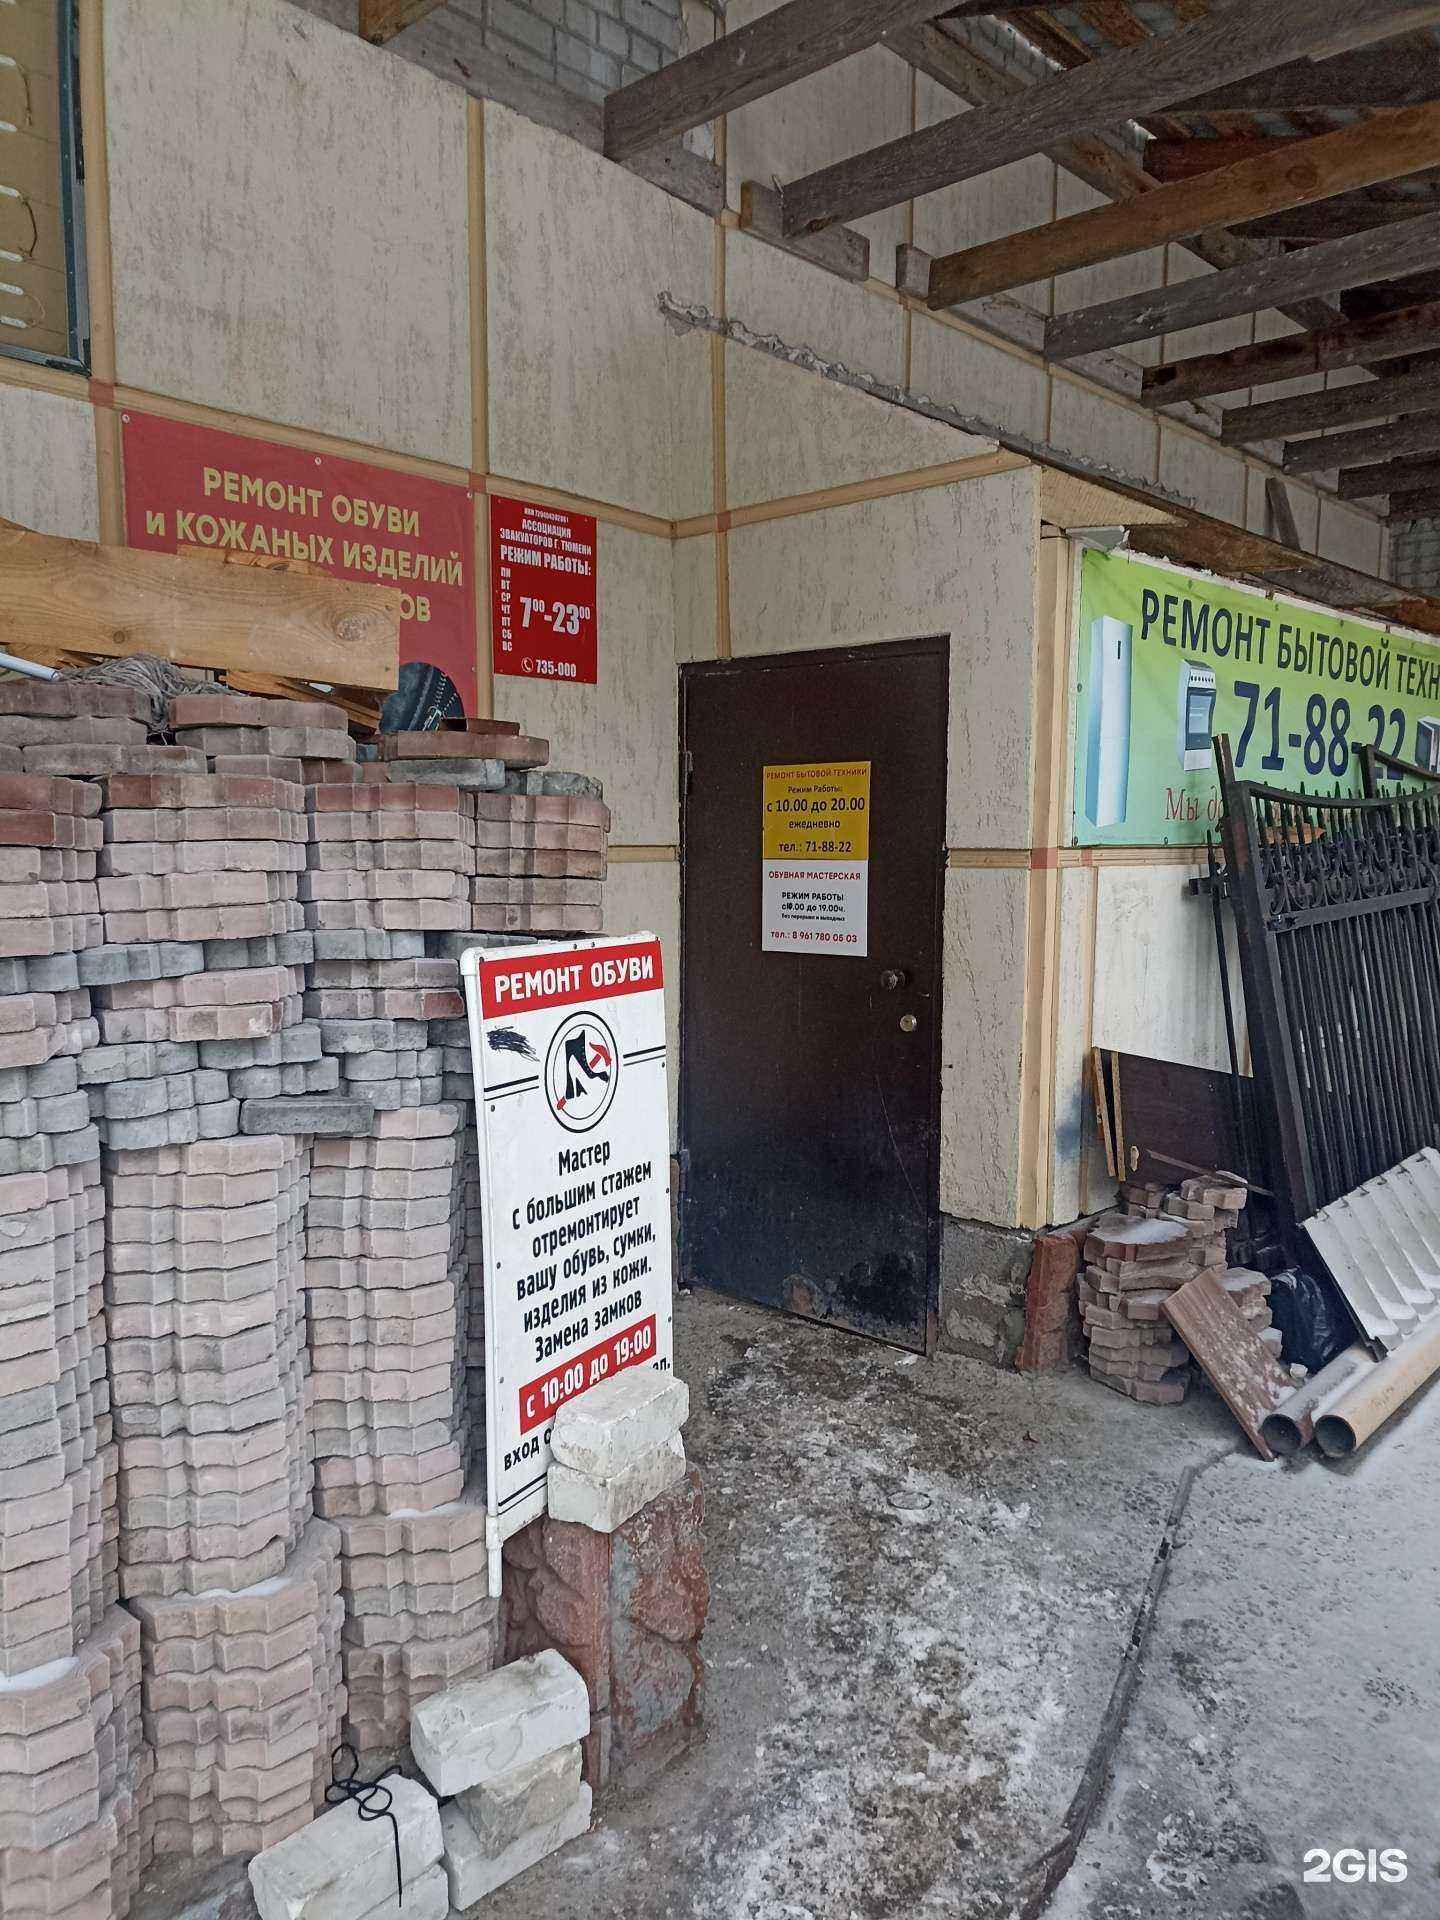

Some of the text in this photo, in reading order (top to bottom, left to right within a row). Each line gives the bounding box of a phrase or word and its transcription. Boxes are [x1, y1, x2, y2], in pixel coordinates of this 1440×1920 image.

[203, 467, 419, 537] РЕМОНТ ОБУВИ
[521, 519, 572, 539] АССОЦИАЦИЯ
[176, 510, 334, 565] КОЖАНЫХ
[343, 541, 463, 586] ИЗДЕЛИЙ
[500, 528, 553, 548] ЭВАКУАТОРОВ
[561, 540, 592, 556] ТЮМЕНИ
[500, 544, 592, 577] РЕЖИМ РАБОТЫ:
[500, 567, 511, 578] ПН
[501, 579, 511, 590] ВТ
[501, 592, 511, 603] СР
[501, 604, 511, 615] ЧТ
[501, 617, 511, 627] ПТ
[501, 629, 512, 640] СБ
[1141, 588, 1271, 664] РЕМОНТ
[1277, 624, 1391, 691] БЫТОВОЙ
[502, 641, 513, 652] ВС
[536, 659, 577, 678] 735-000
[1233, 681, 1406, 781] 71-88-22
[767, 768, 867, 780] РЕМОНТ БЫТОВОЙ ТЕХНИКИ
[788, 786, 812, 794] Режим
[775, 799, 808, 812] 10.00
[811, 801, 827, 814] до
[831, 797, 865, 811] 20.00
[1164, 787, 1200, 821] Мы
[789, 820, 841, 830] ежедневно
[805, 841, 852, 853] 71-88-22
[768, 871, 861, 880] ОБУВНАЯ МАСТЕРСКАЯ
[782, 892, 844, 901] РЕЖИМ РАБОТЫ
[792, 931, 798, 939] 8
[800, 931, 813, 940] 961
[815, 932, 831, 941] 780
[846, 934, 858, 943] 03
[493, 955, 654, 1003] РЕМОНТ ОБУВИ
[558, 1140, 611, 1177] Мастер
[526, 1181, 596, 1225] большим
[601, 1161, 652, 1196] стажем
[532, 1196, 640, 1258] отремонтирует
[517, 1222, 656, 1301] вашу обувь, сумки,
[524, 1256, 652, 1333] изделия из кожи.
[535, 1291, 642, 1363] Замена замков
[540, 1362, 584, 1409] 10:00
[589, 1353, 609, 1386] до
[613, 1325, 651, 1365] 19:00
[504, 1436, 540, 1471] вход
